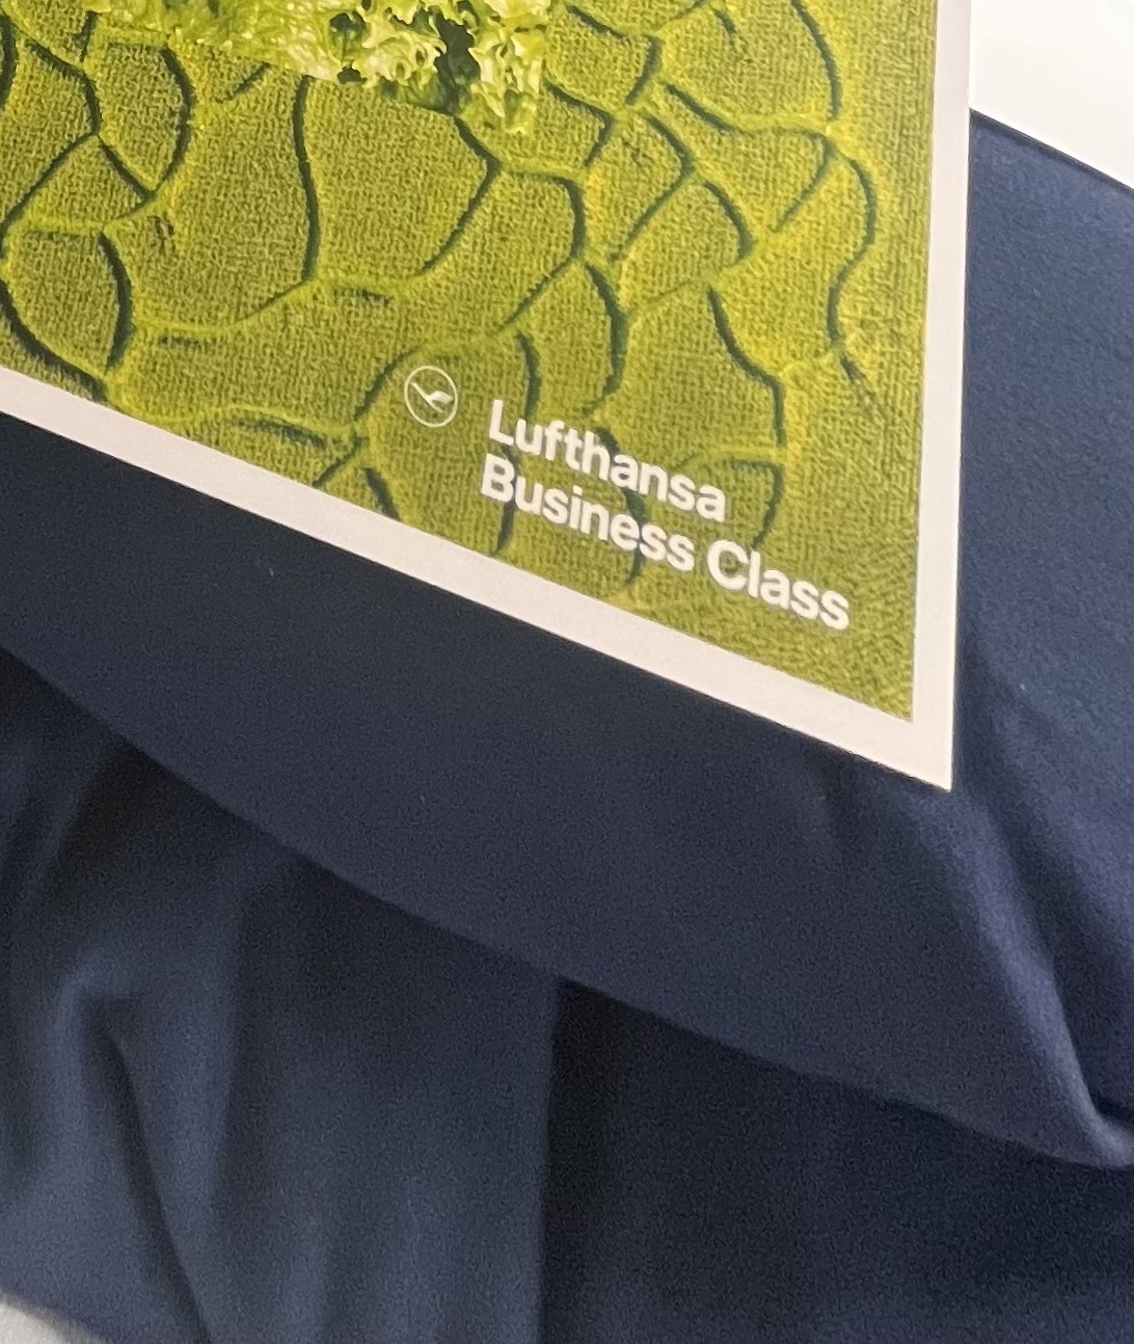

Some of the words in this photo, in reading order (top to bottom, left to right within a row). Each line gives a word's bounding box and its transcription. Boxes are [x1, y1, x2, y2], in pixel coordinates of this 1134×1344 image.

[488, 398, 727, 524] Lufthansa
[481, 453, 697, 574] Business
[707, 538, 851, 633] Class
